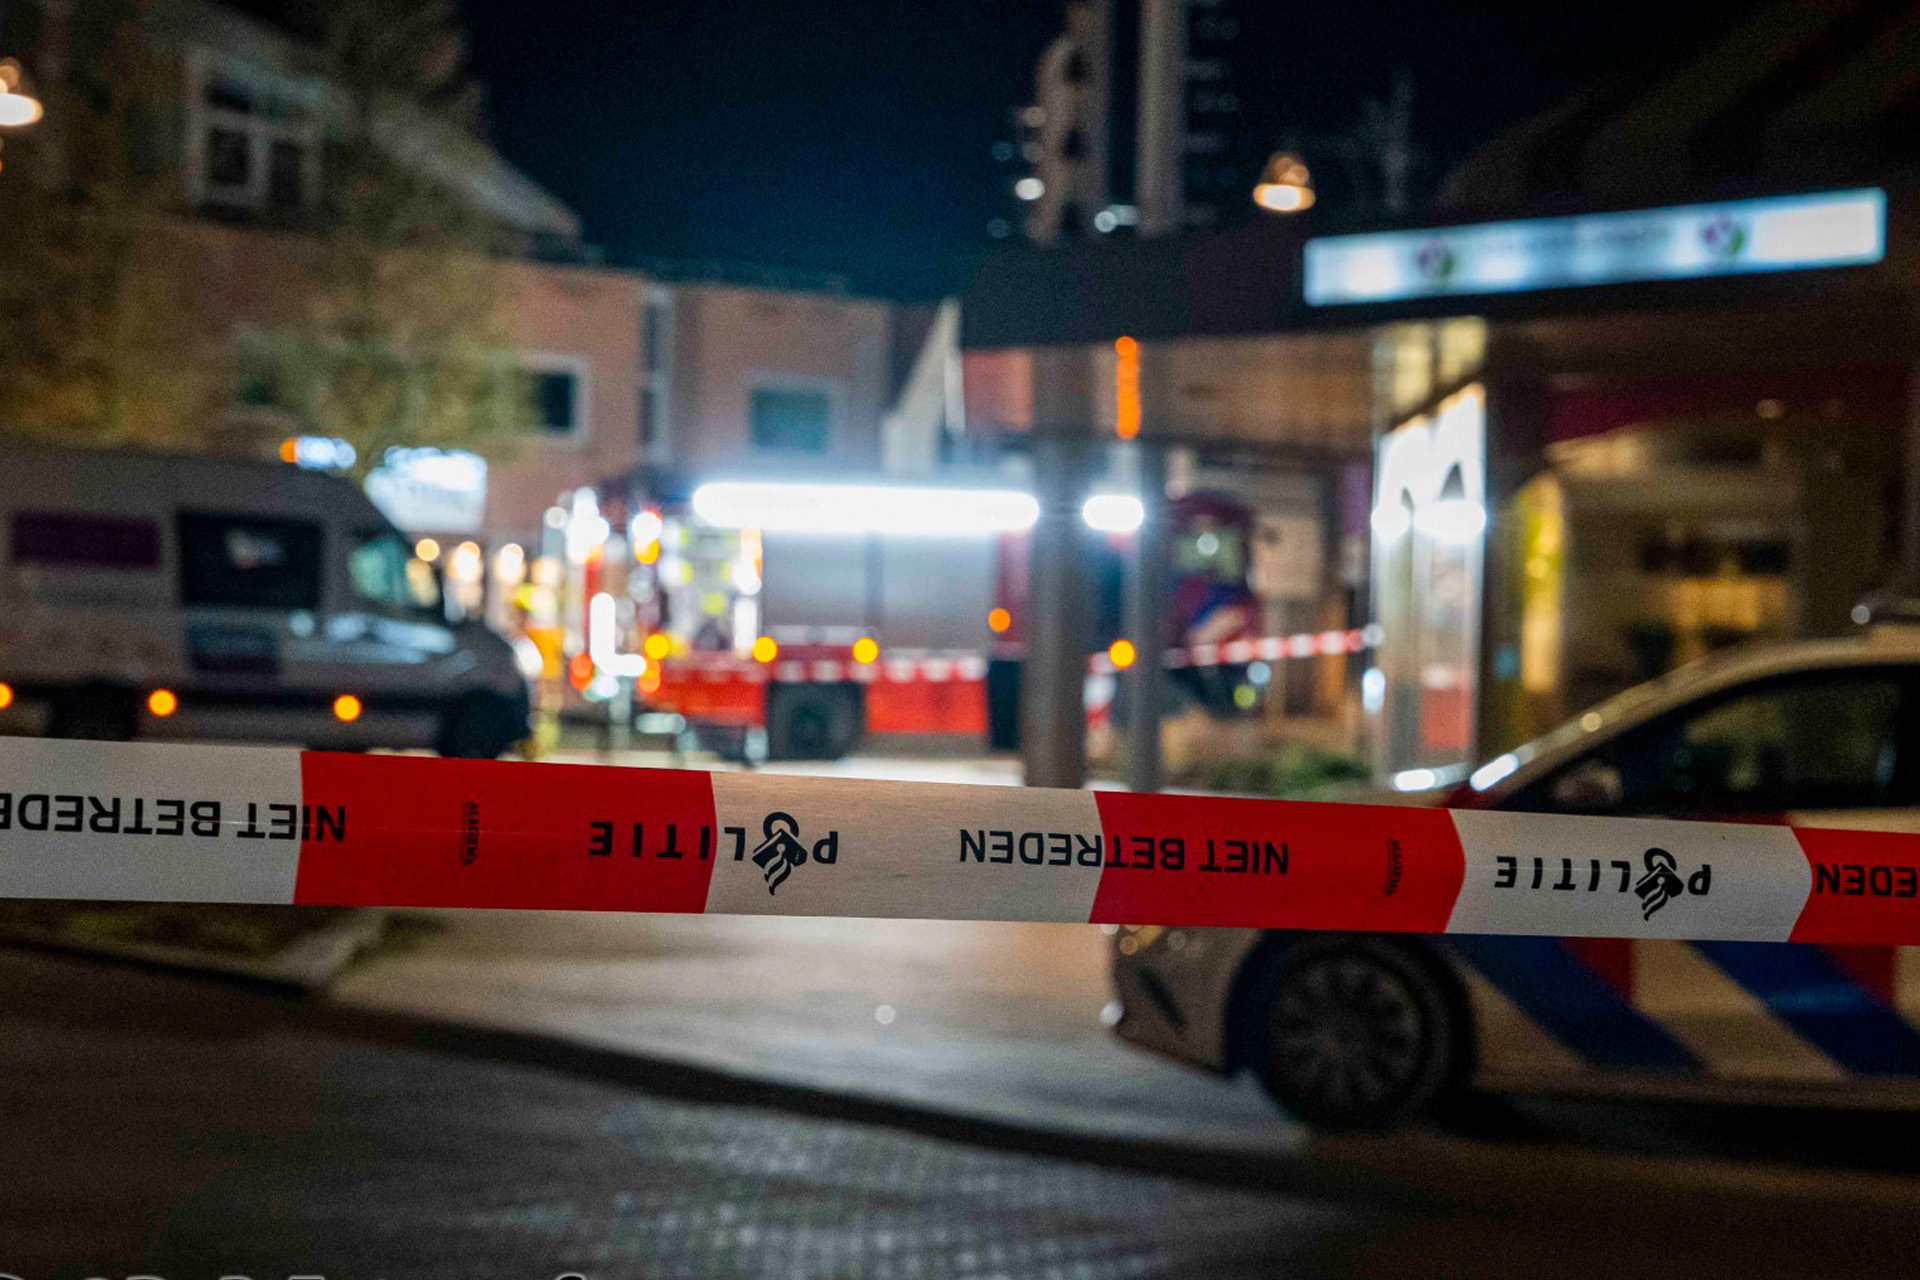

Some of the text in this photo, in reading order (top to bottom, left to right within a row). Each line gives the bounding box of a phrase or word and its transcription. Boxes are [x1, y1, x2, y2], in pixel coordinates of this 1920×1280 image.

[237, 803, 345, 841] NIET
[960, 829, 1290, 874] NIET BETREDEN
[1816, 864, 1920, 897] EDEN
